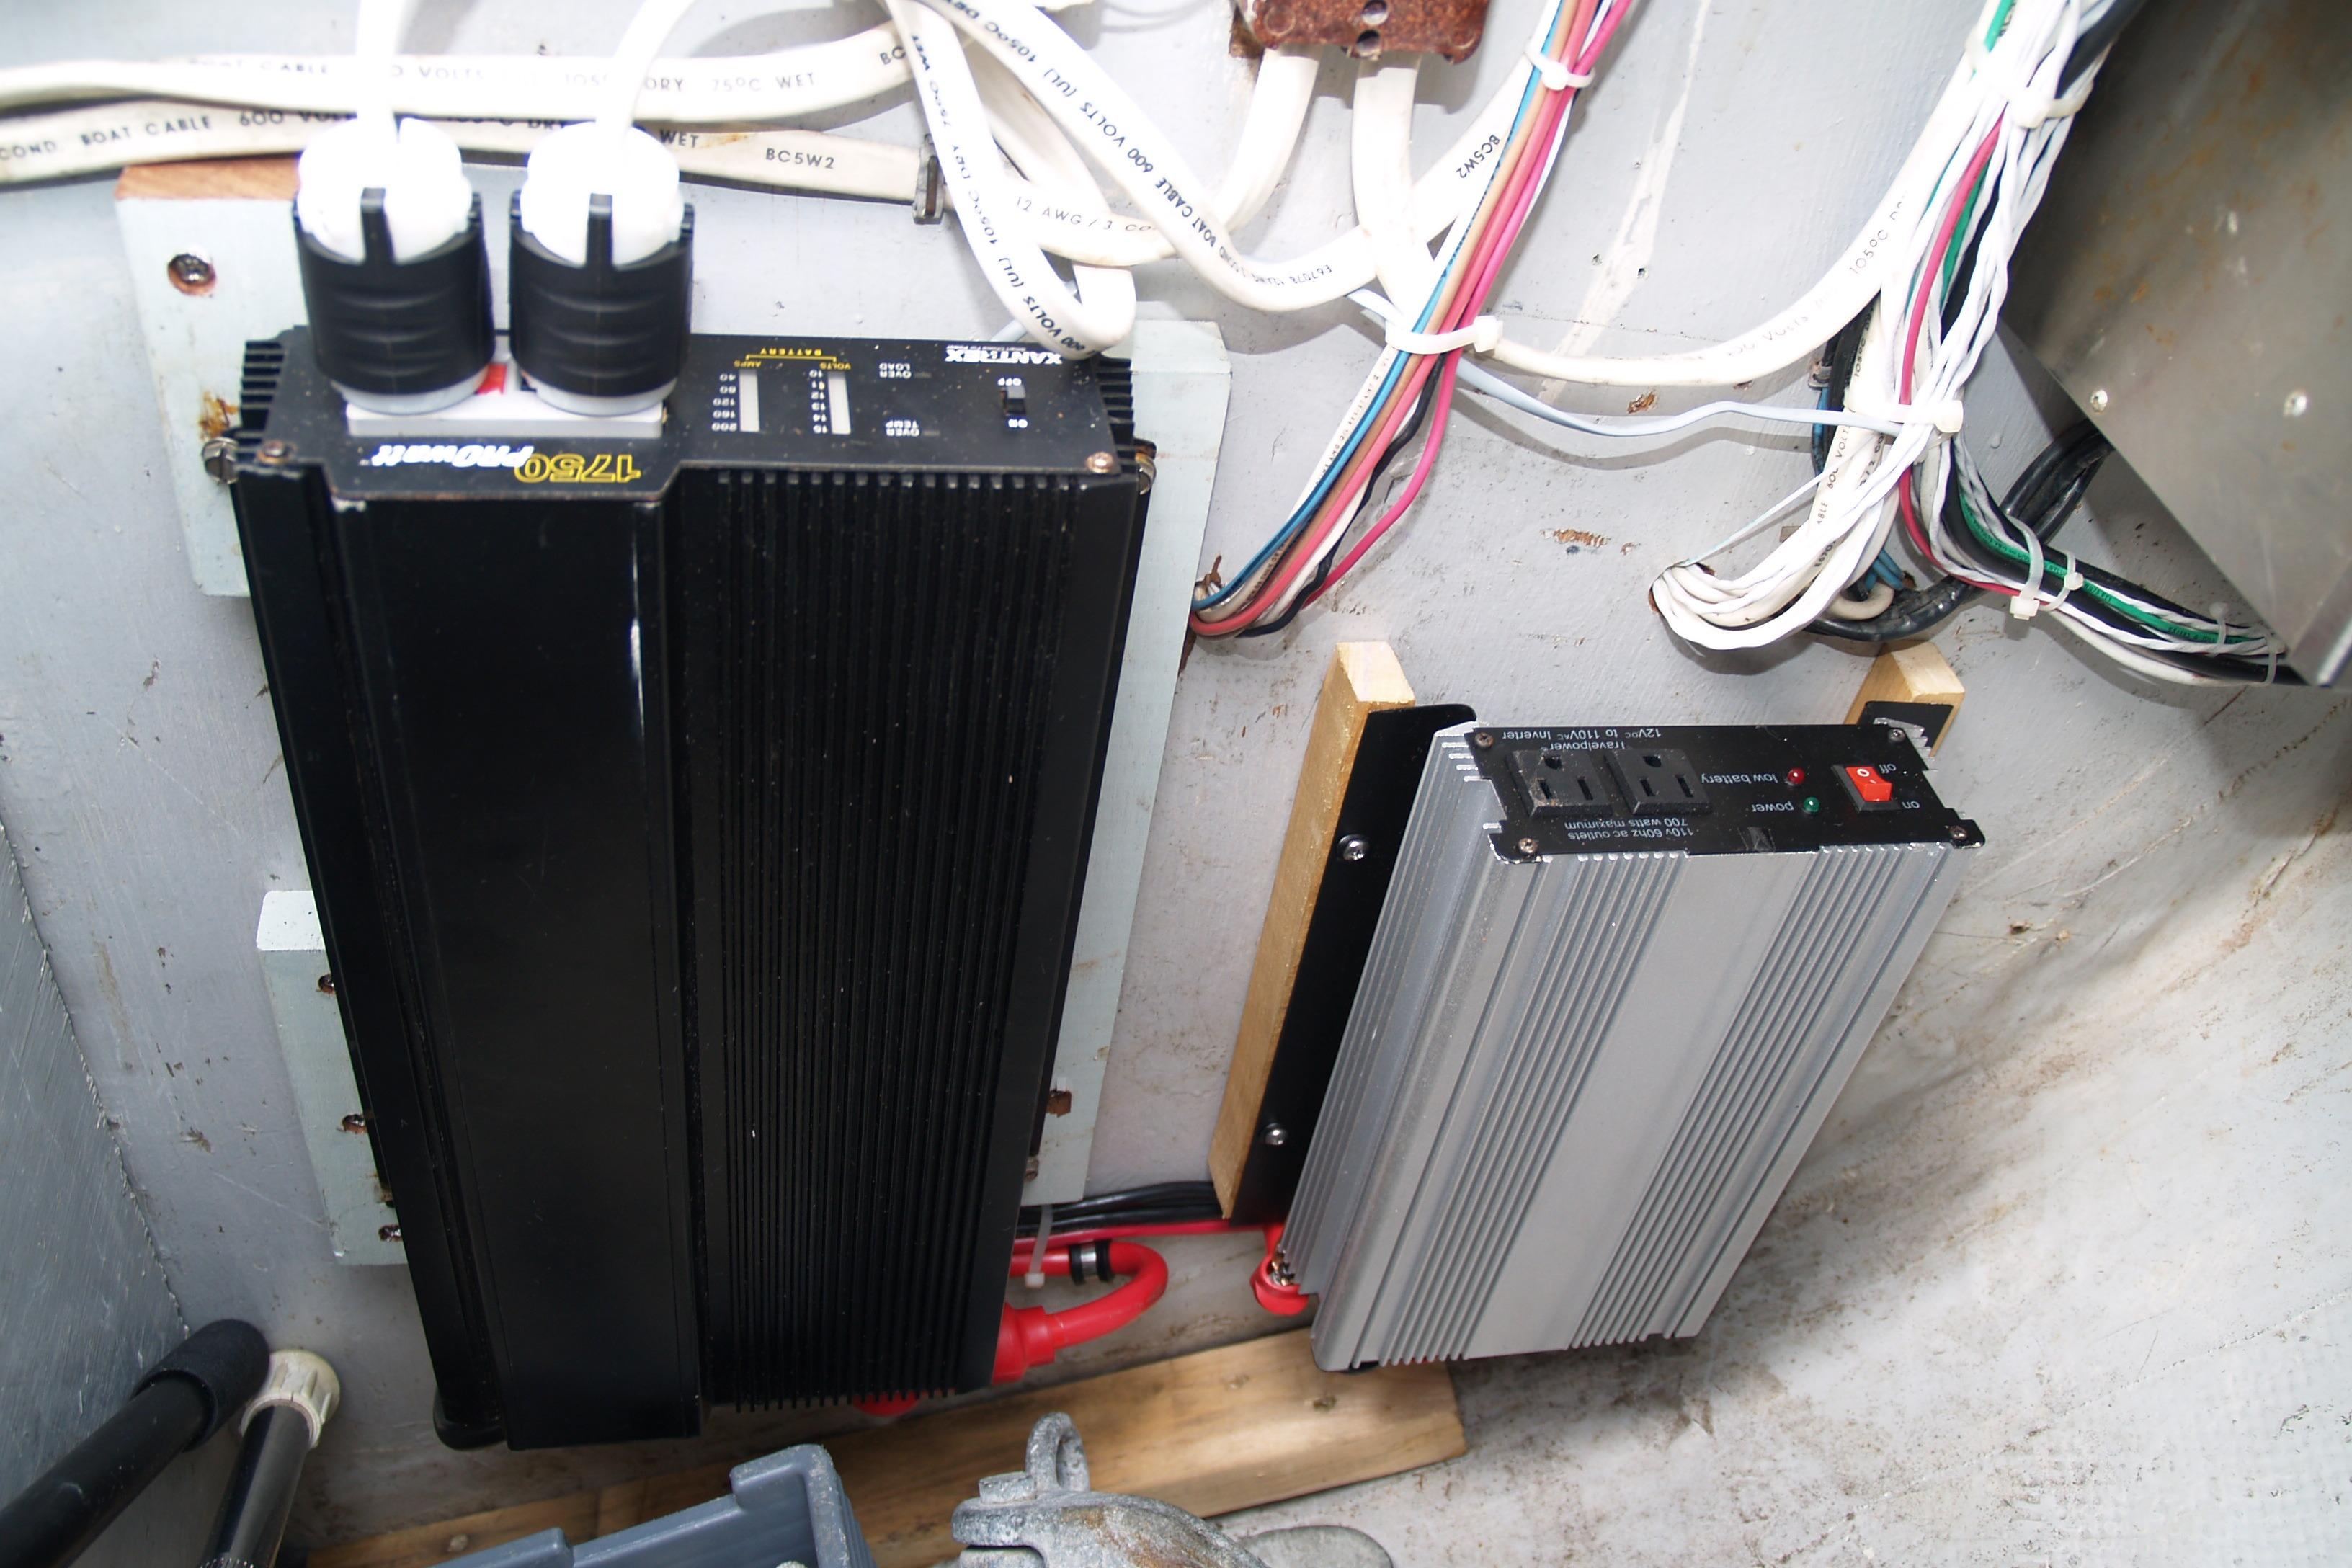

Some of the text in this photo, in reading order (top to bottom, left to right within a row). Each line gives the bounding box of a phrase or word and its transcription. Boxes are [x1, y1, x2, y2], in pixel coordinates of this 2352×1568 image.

[775, 72, 816, 89] WET
[879, 45, 906, 66] BC
[1079, 102, 1126, 148] VOLTS
[80, 126, 132, 146] BOAT
[145, 115, 212, 136] CABLE
[239, 110, 284, 127] 600
[659, 129, 698, 148] WET
[765, 147, 836, 170] BC5W2
[1127, 148, 1154, 173] 600
[1455, 133, 1501, 179] BC5W2
[1154, 177, 1193, 218] CABLE
[1015, 196, 1033, 212] 12
[1041, 206, 1083, 226] AWG
[1124, 223, 1154, 233] CO
[1022, 295, 1063, 337] VOLTS
[760, 347, 822, 356] BATTERY
[944, 349, 1063, 365] XANTREX
[733, 360, 762, 368] AMPS
[819, 361, 852, 371] VOLTS
[878, 362, 911, 371] LOAD
[720, 373, 736, 382] 40
[808, 369, 824, 378] 10
[879, 370, 912, 378] OVER
[811, 380, 825, 390] 11
[997, 378, 1023, 386] OFF
[810, 391, 826, 400] 12
[713, 397, 735, 406] 120
[811, 401, 827, 411] 13
[713, 409, 736, 419] 160
[812, 413, 828, 422] 14
[711, 422, 738, 432] 200
[884, 419, 919, 428] TEMP
[1007, 418, 1028, 428] ON
[812, 424, 829, 434] 15
[885, 428, 919, 437] OVER
[370, 443, 534, 468] PROwatt
[513, 453, 642, 484] 1750
[1502, 729, 1551, 741] Inverter
[1605, 729, 1618, 740] to
[1879, 762, 1897, 775] off
[1700, 772, 1779, 785] low battery
[1750, 801, 1795, 814] power
[1901, 800, 1921, 810] on
[1564, 816, 1689, 832] 700 watts maximum
[1567, 827, 1694, 842] 110v 60hz ac outlets
